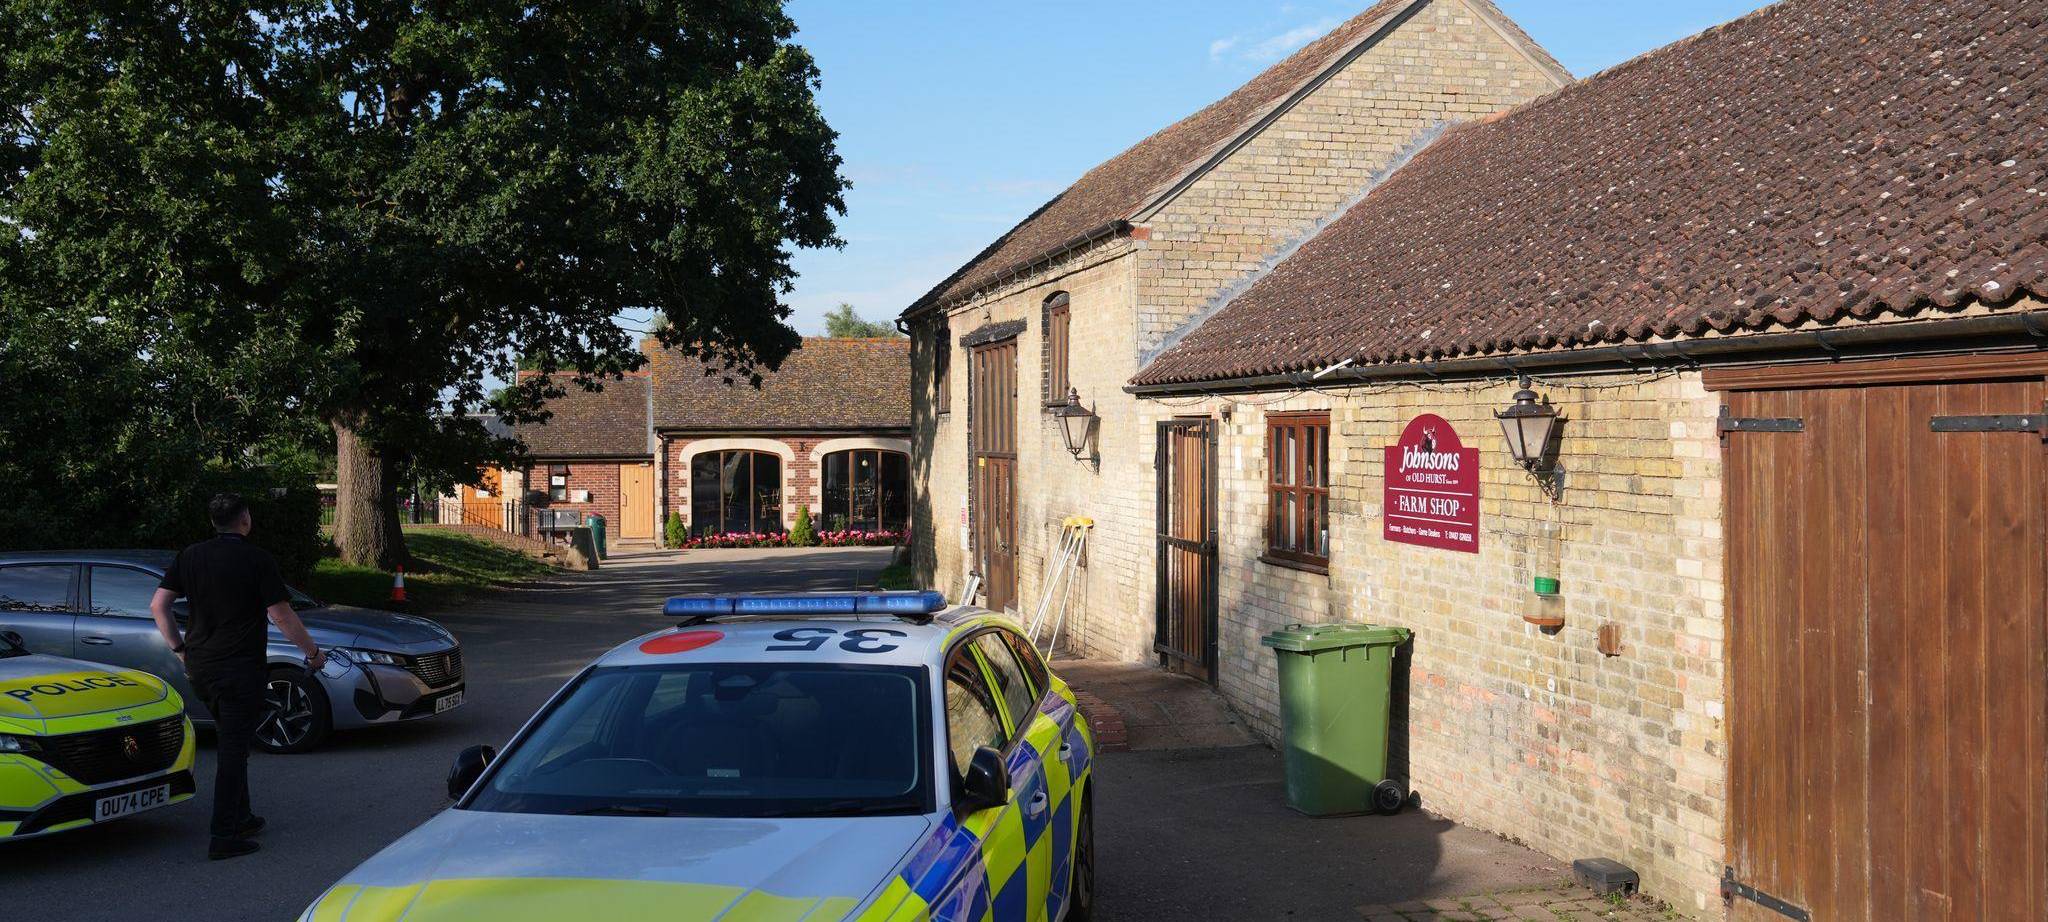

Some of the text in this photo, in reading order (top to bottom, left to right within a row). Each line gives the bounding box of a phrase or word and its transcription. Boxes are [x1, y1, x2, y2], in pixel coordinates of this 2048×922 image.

[1399, 445, 1460, 473] Johnsons
[1412, 472, 1425, 483] OLD
[1425, 473, 1447, 484] HURST
[1399, 495, 1460, 517] FARM SHOP
[765, 627, 908, 654] 35
[5, 676, 138, 702] POLICE
[102, 786, 165, 817] OU74 CPE
